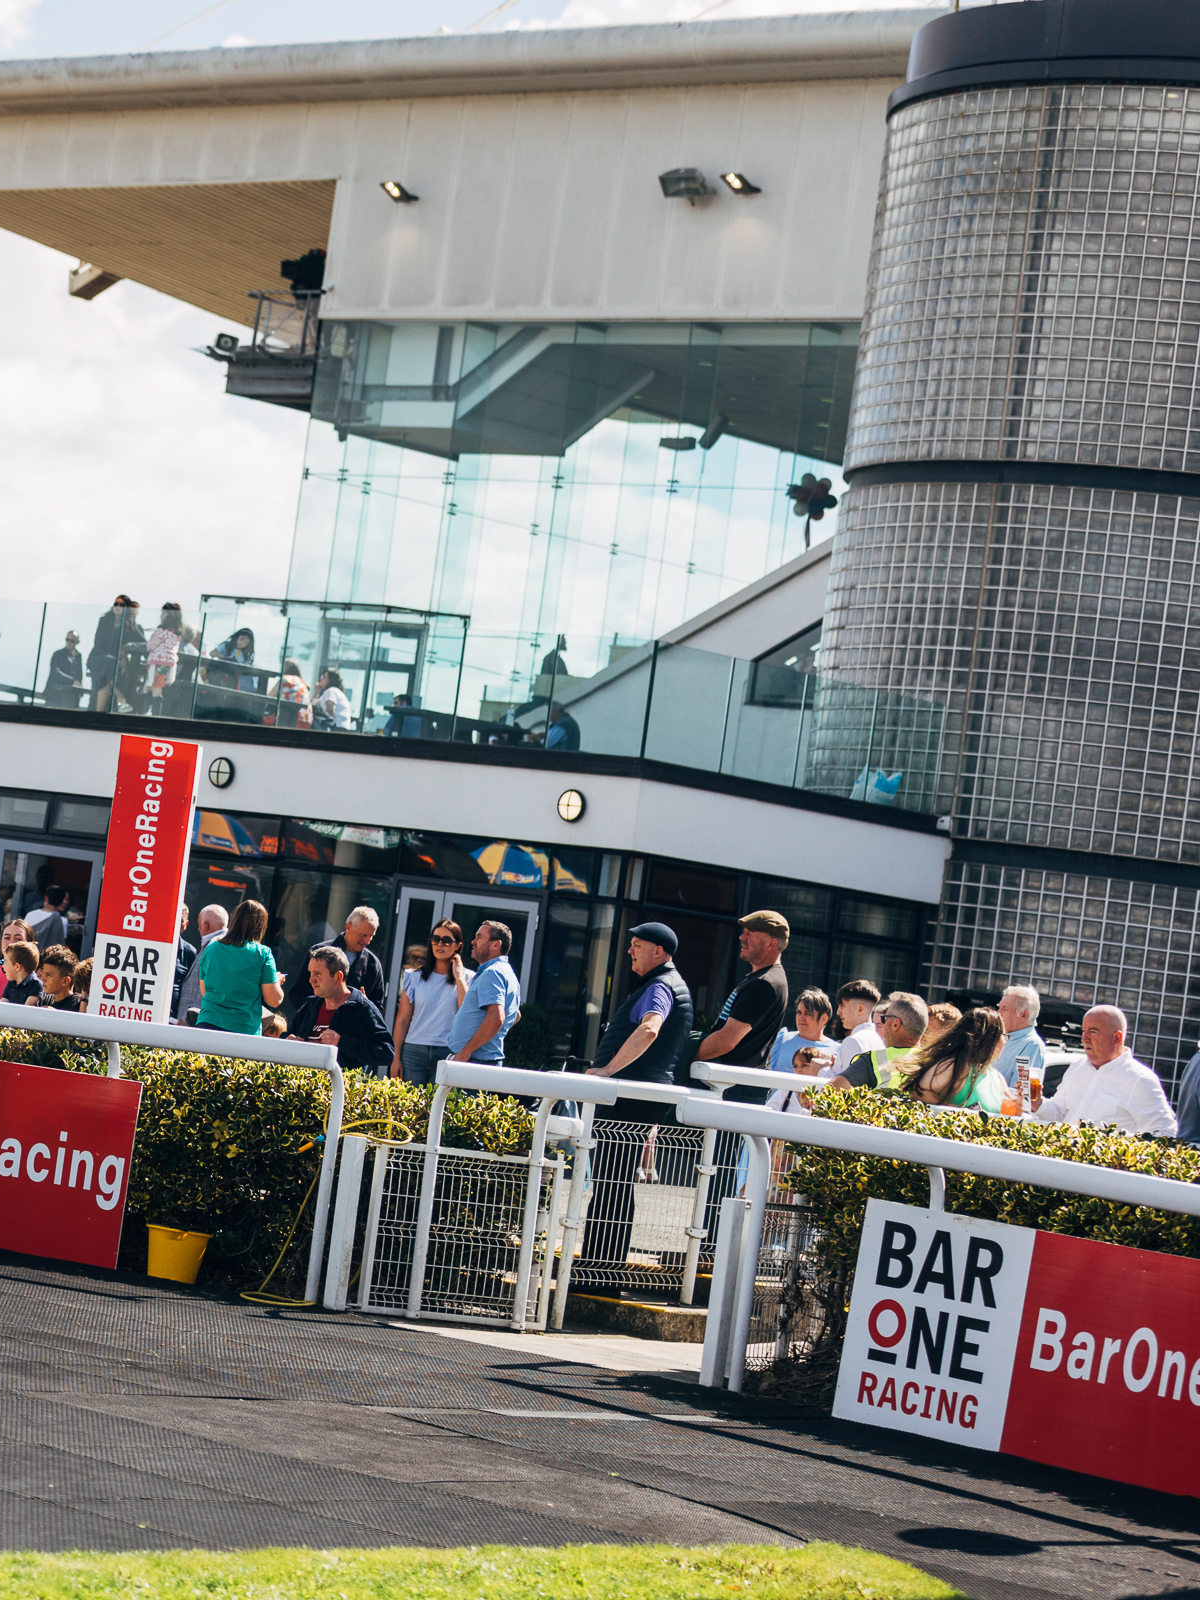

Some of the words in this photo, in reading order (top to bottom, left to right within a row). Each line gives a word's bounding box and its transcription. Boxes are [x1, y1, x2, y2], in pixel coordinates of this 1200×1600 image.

[122, 741, 174, 932] BarOneRacing
[103, 942, 160, 977] BAR
[98, 1002, 153, 1023] RACING
[101, 973, 156, 1007] ONE
[875, 1219, 1004, 1310] BAR
[867, 1298, 991, 1385] ONE
[856, 1370, 979, 1430] RACING
